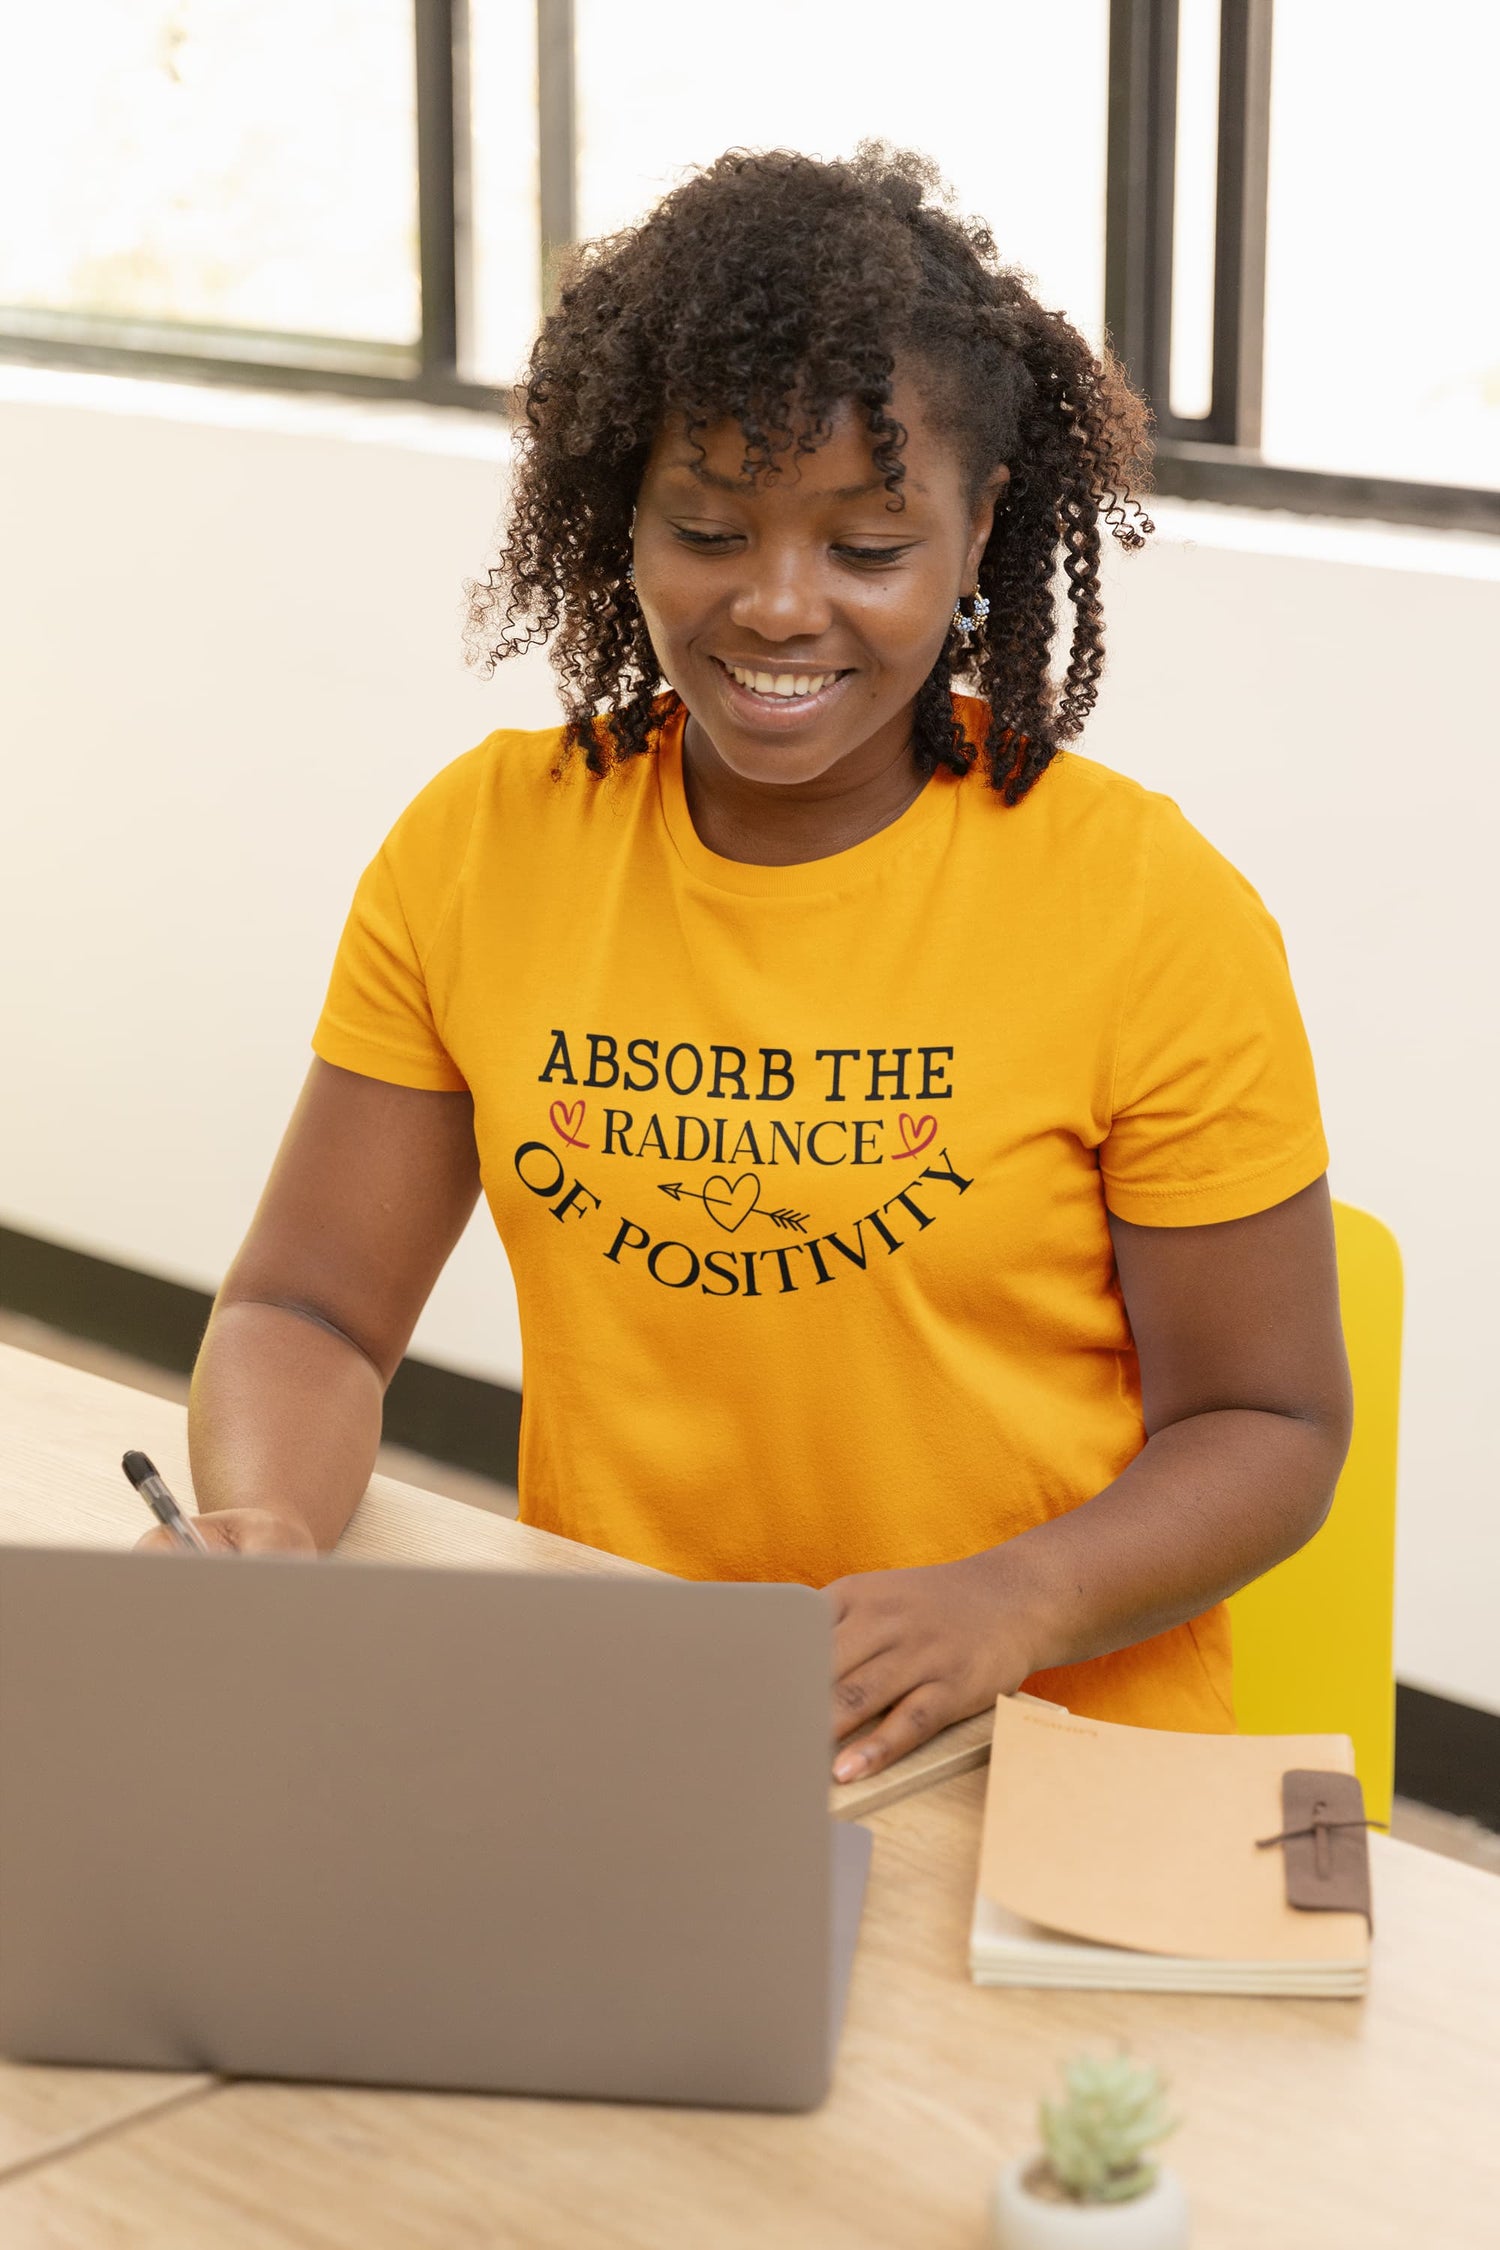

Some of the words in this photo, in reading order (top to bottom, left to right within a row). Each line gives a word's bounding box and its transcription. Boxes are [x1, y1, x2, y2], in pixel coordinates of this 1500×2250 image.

[538, 1030, 795, 1101] ABSORB
[816, 1046, 954, 1102] THE
[601, 1108, 884, 1166] RADIANCE
[514, 1141, 602, 1223] OF
[603, 1148, 974, 1297] POSITIVITY
